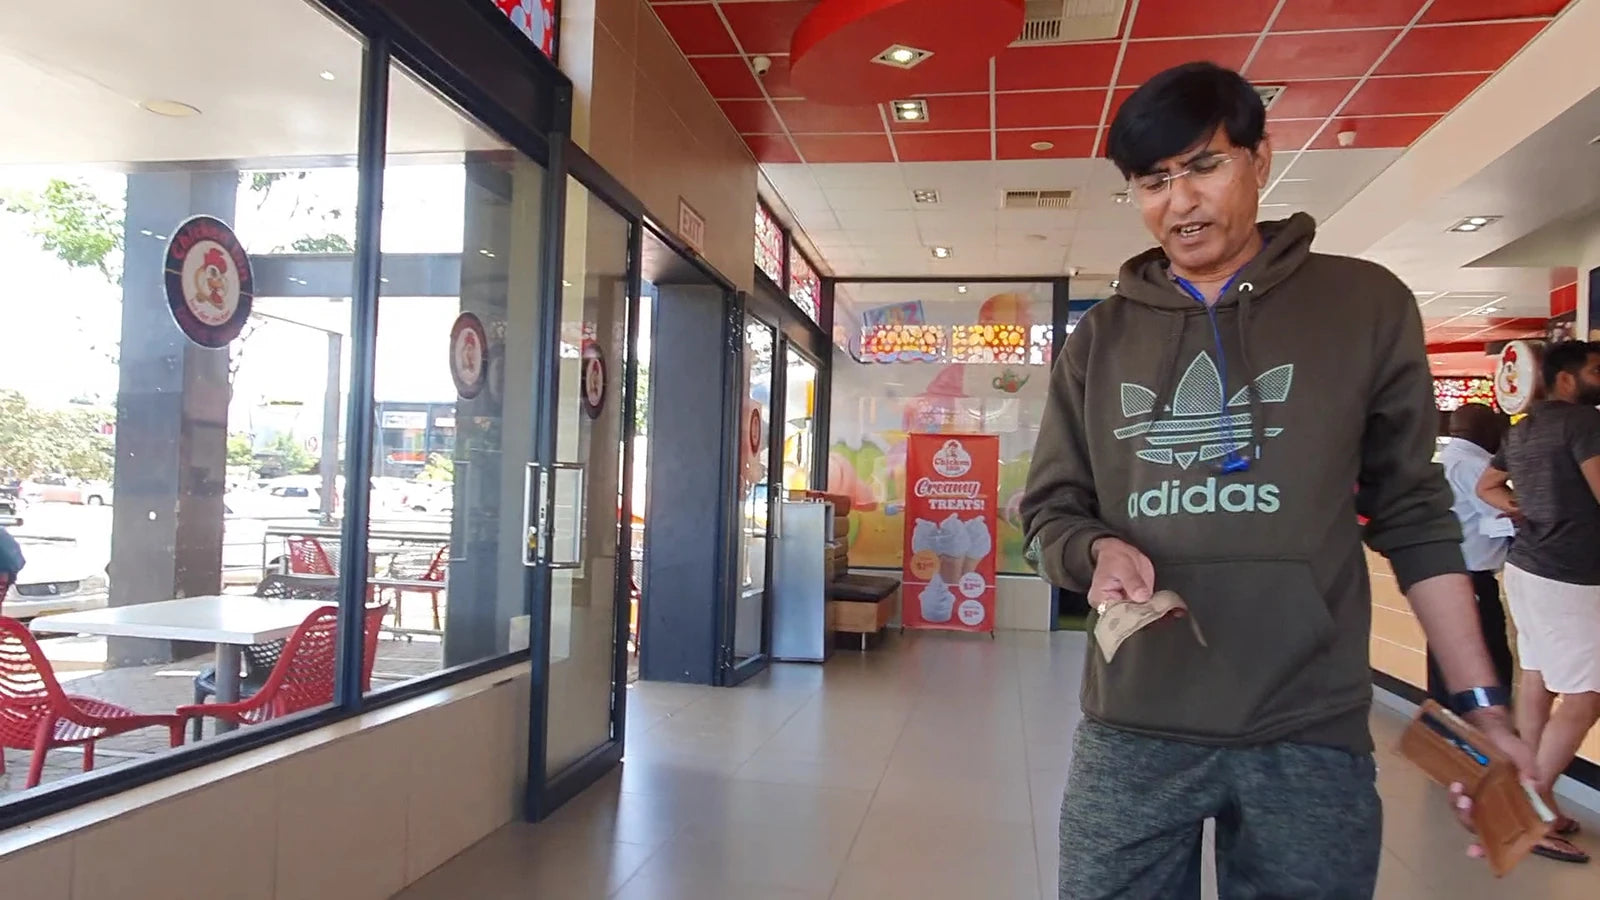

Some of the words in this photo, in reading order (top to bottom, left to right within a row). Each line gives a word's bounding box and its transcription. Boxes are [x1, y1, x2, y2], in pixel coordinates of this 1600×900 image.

[915, 478, 980, 498] Creamy
[1127, 476, 1281, 518] adidas
[929, 499, 985, 510] TREATS!
